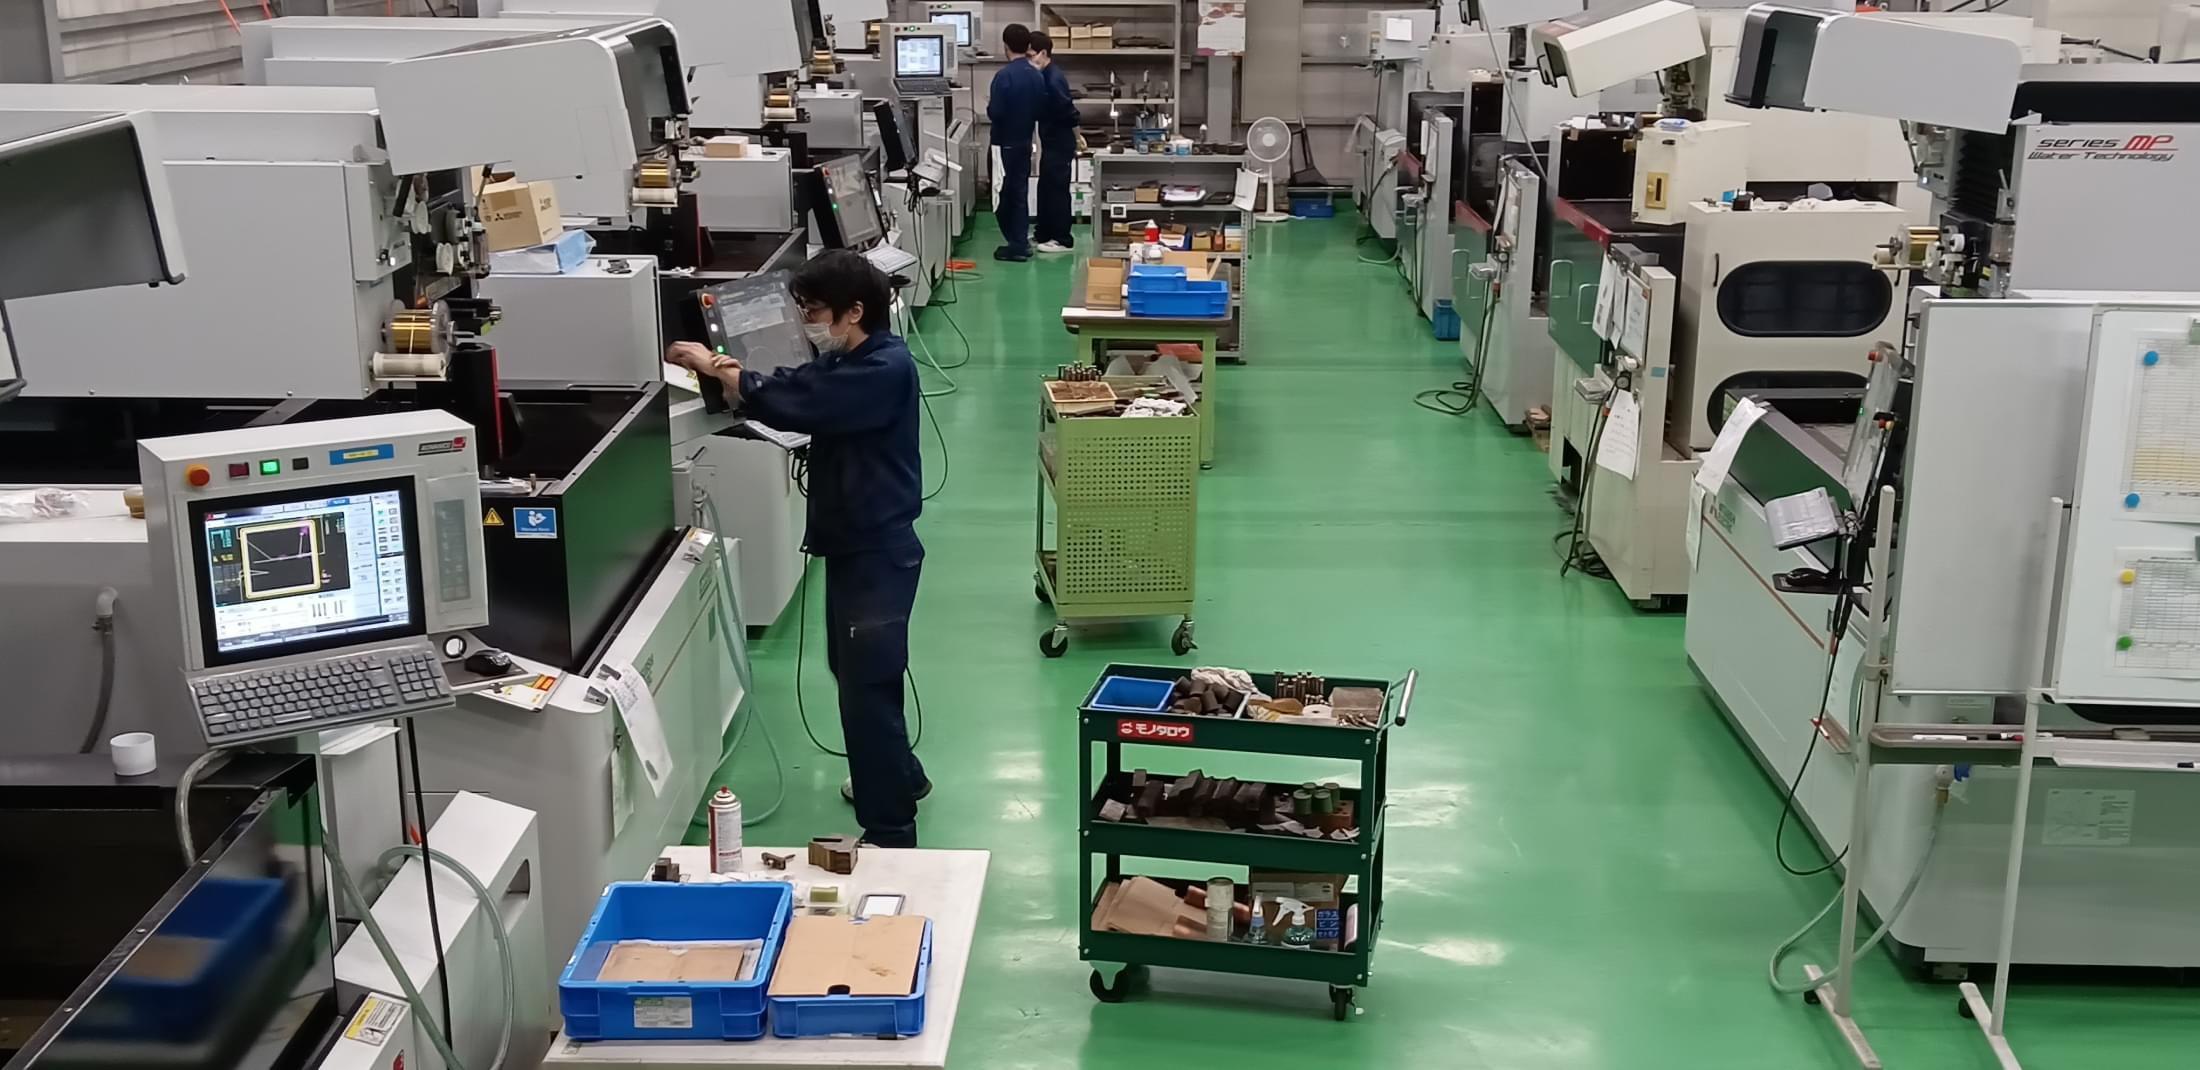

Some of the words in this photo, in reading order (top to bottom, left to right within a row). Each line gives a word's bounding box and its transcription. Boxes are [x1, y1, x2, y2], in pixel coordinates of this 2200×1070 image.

[2037, 138, 2120, 148] series
[2124, 135, 2174, 150] MP
[2028, 151, 2081, 160] Water
[2084, 151, 2174, 162] Technology
[1135, 723, 1190, 737] モノタロウ
